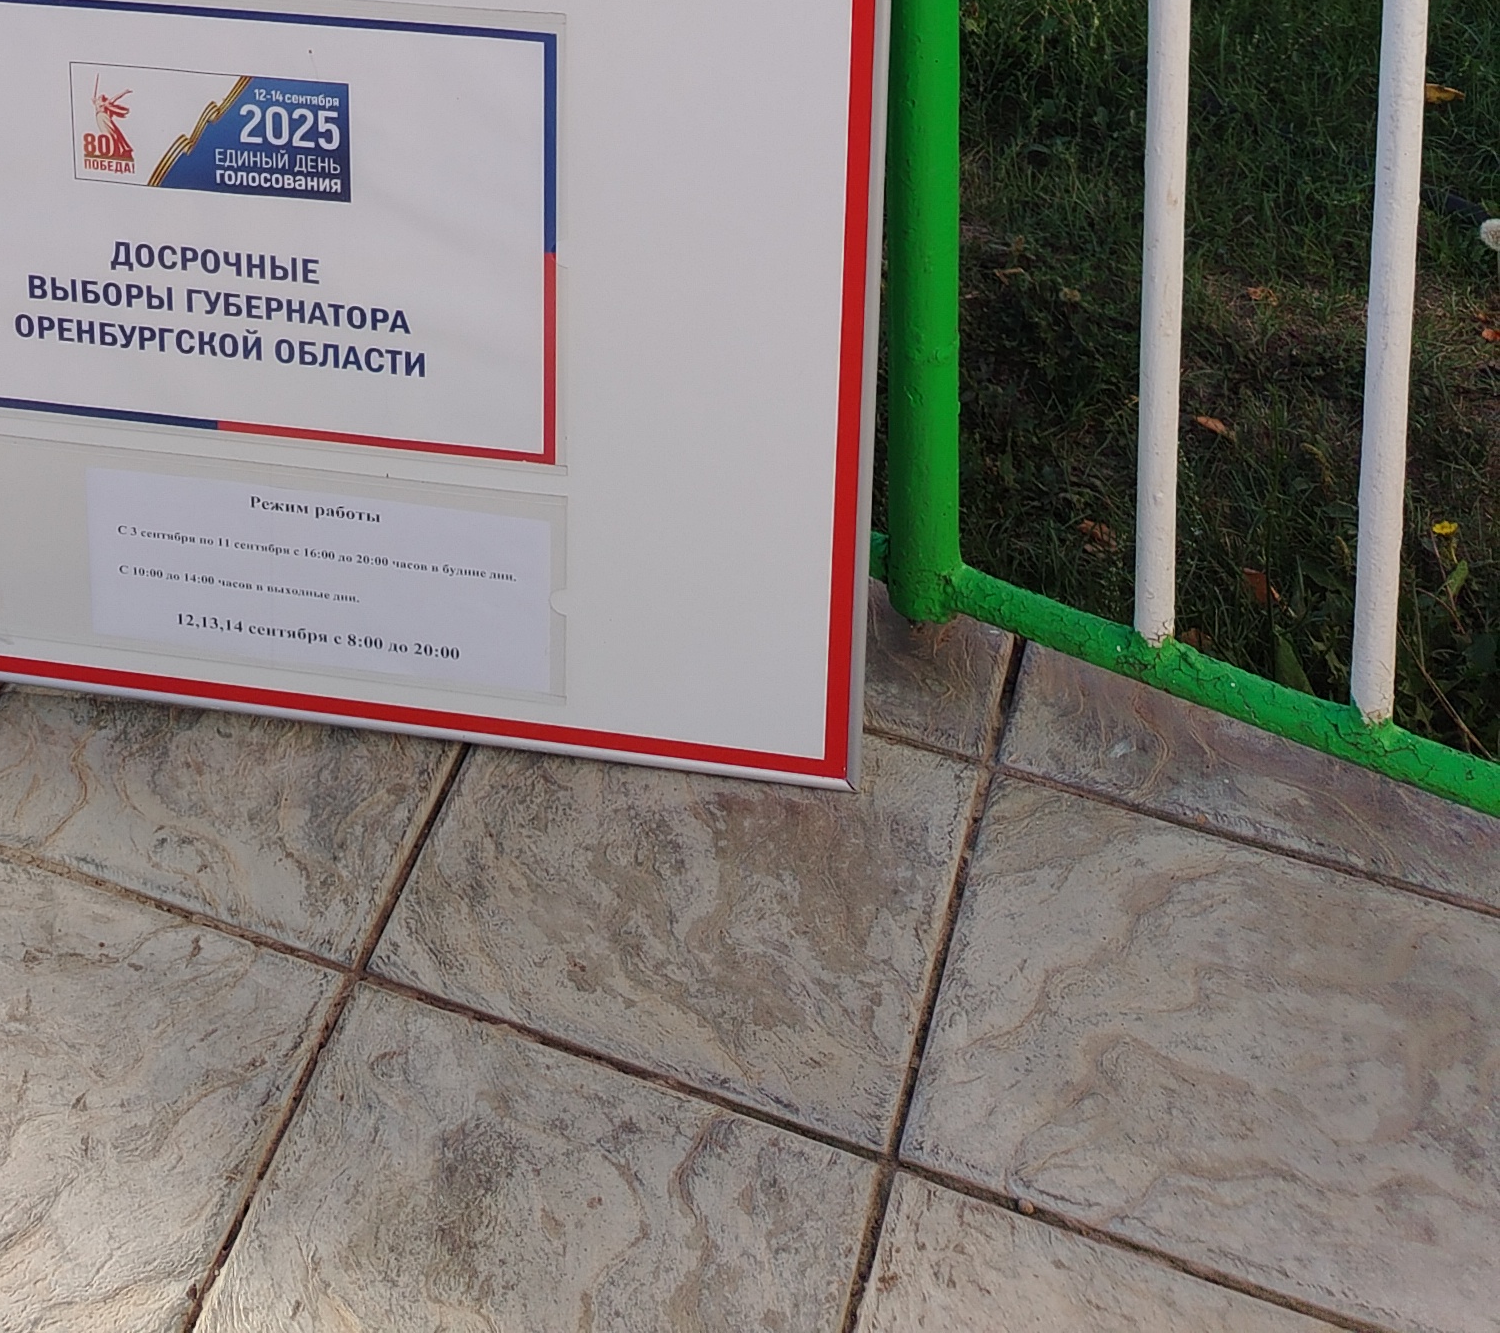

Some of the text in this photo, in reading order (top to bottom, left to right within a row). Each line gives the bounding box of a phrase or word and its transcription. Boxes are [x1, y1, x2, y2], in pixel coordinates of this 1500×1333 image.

[254, 89, 339, 107] 12-14 сентября
[83, 133, 111, 157] 80
[239, 105, 341, 150] 2025
[84, 158, 135, 174] ПОБЕДА!
[215, 148, 341, 174] ЕДИНЫЙ ДЕНЬ
[216, 169, 341, 193] голосования
[110, 241, 320, 285] ДОСРОЧНЫЕ
[28, 274, 411, 334] ВЫБОРЫ ГУБЕРНАТОРА
[14, 313, 426, 378] ОРЕНБУРГСКОЙ ОБЛАСТИ
[250, 495, 381, 523] Режим работы
[118, 525, 127, 535] С
[130, 527, 137, 536] 3
[140, 529, 196, 544] сентября
[200, 537, 214, 546] по
[218, 538, 230, 548] 11
[234, 541, 289, 556] сентября
[293, 548, 299, 556] с
[304, 548, 335, 560] 16:00
[338, 554, 352, 563] до
[356, 554, 388, 566] 20:00
[392, 560, 427, 571] часов
[442, 564, 486, 578] будние
[489, 572, 517, 582] дни.
[119, 565, 360, 603] С 10:00 до 14:00 часов в выходные дни.
[176, 612, 461, 661] 12,13,14 сентября с 8:00 до 20:00
